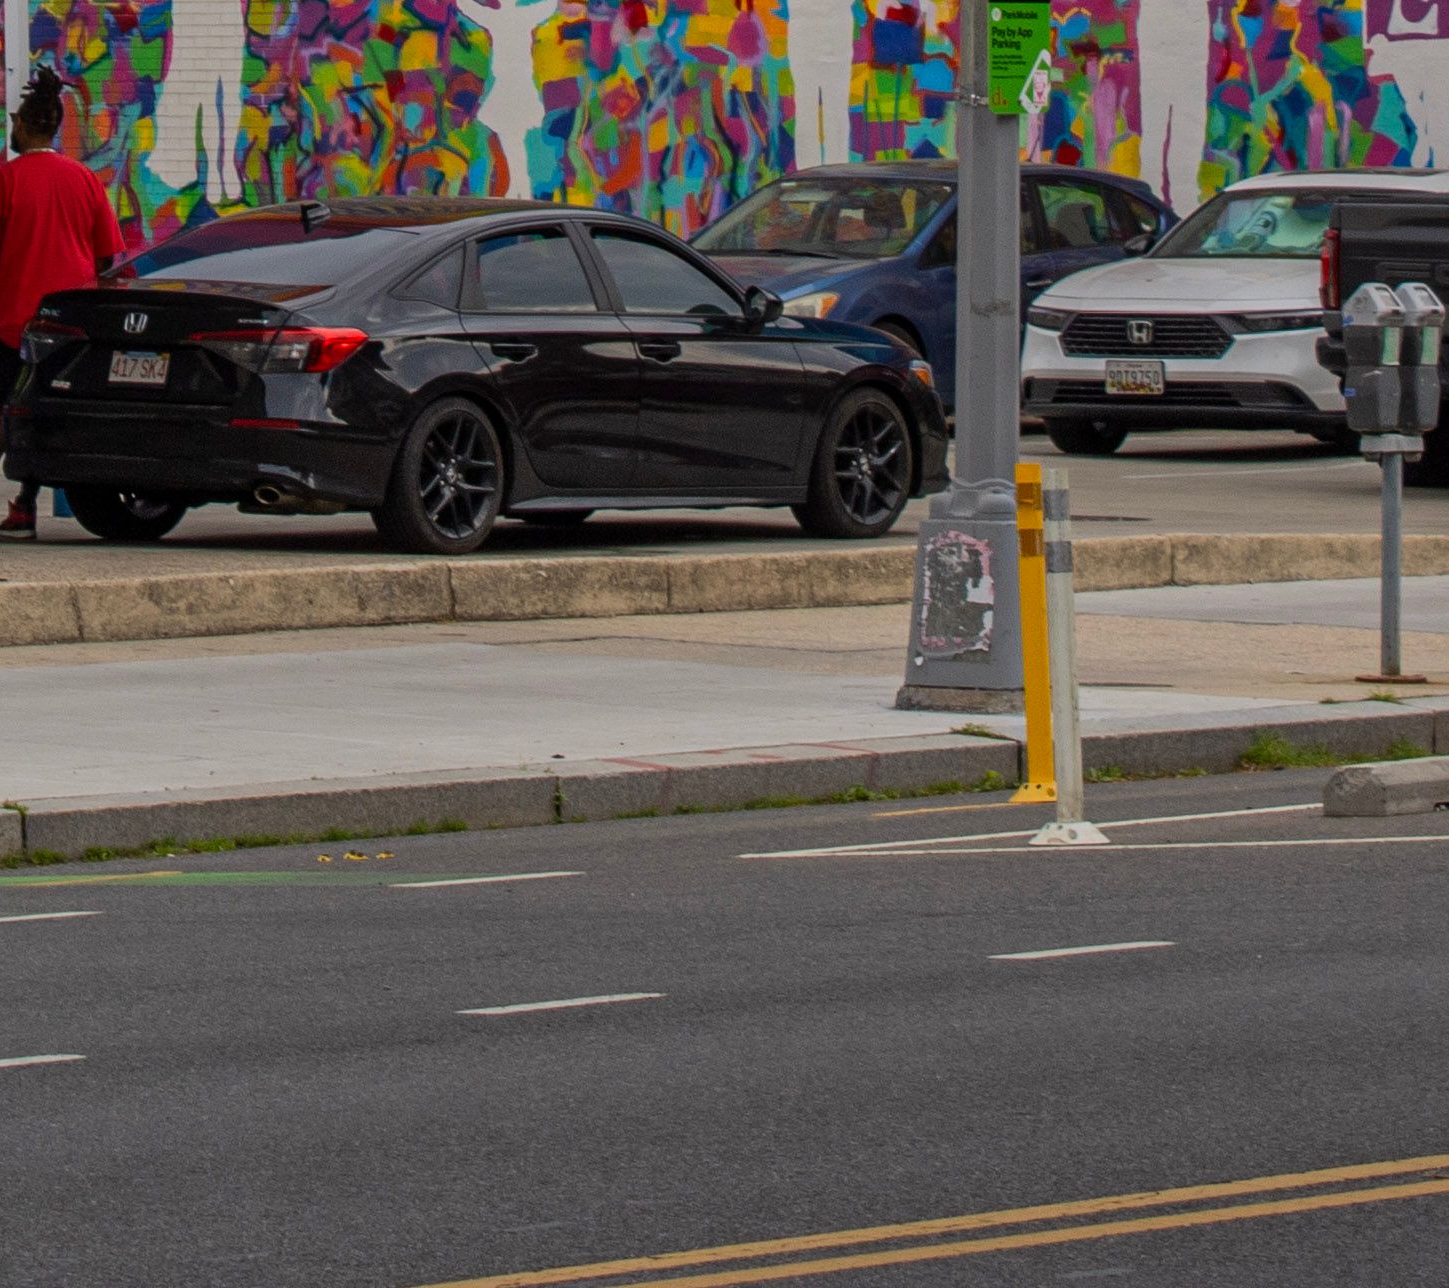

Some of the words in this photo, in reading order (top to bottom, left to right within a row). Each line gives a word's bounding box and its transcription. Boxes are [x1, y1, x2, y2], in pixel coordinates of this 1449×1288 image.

[991, 26, 1006, 38] Pay
[991, 38, 1022, 51] Parking
[111, 357, 138, 376] 417
[142, 359, 167, 378] SK4
